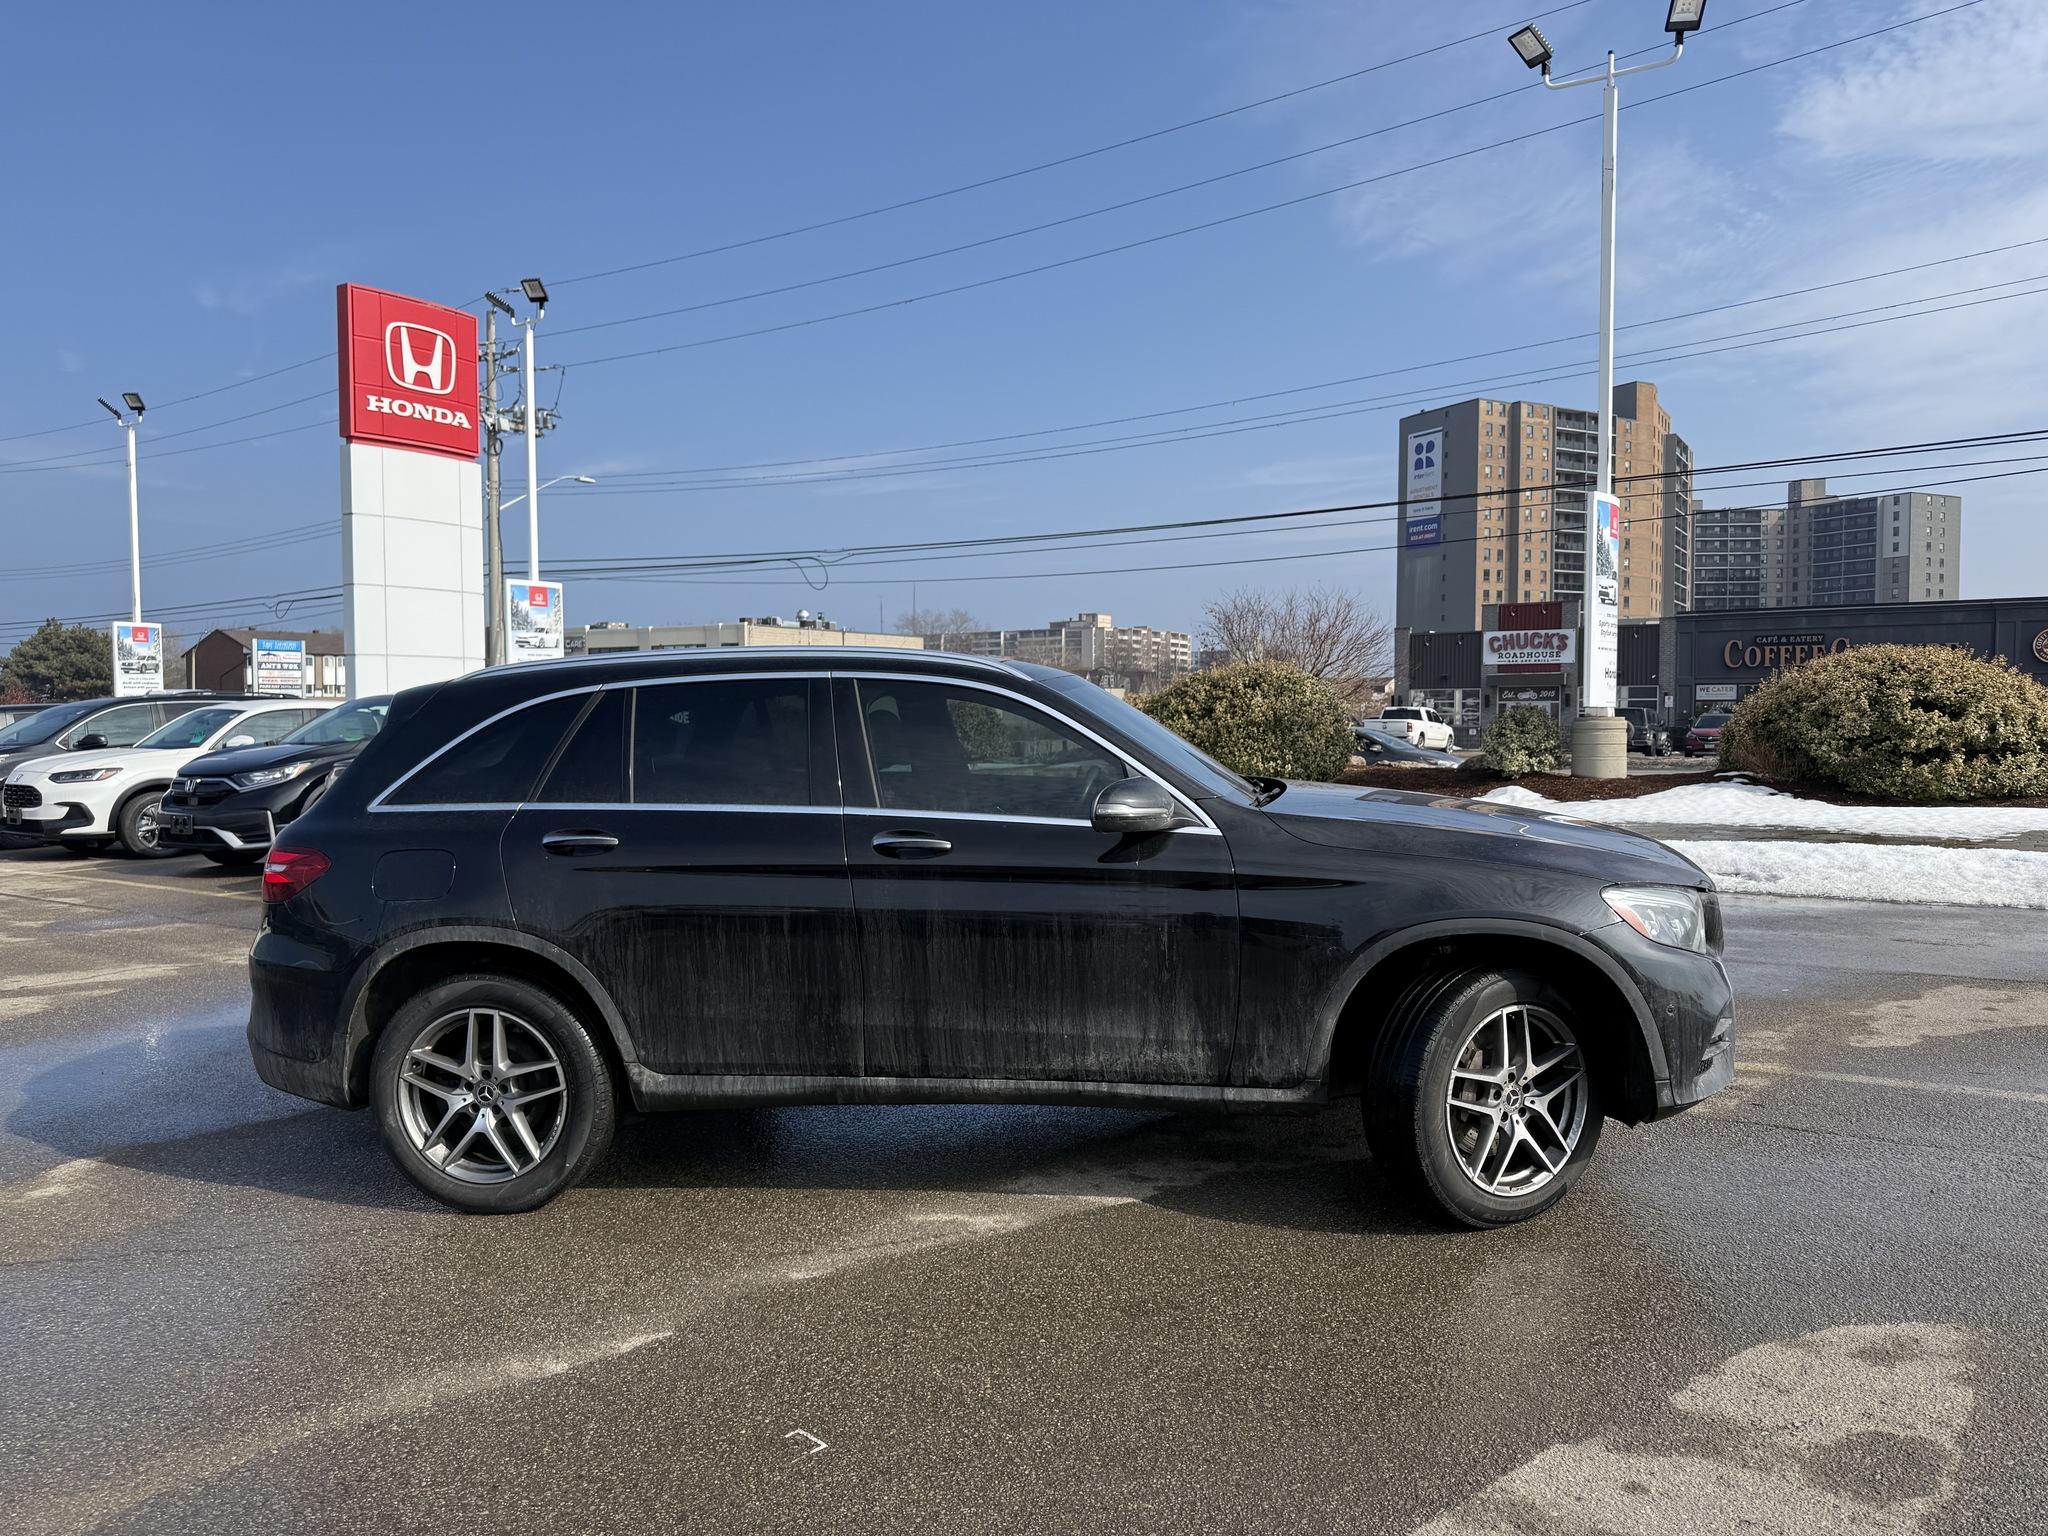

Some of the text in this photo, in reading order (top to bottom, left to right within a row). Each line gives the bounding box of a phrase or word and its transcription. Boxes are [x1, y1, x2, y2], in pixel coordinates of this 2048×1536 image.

[366, 394, 472, 430] HONDA
[1410, 484, 1438, 494] APARTMENT
[1409, 523, 1438, 533] irent.com
[1489, 632, 1569, 653] CHUCK'S
[1498, 651, 1561, 659] ROADHOUSE
[1502, 690, 1556, 699] Est. 2015
